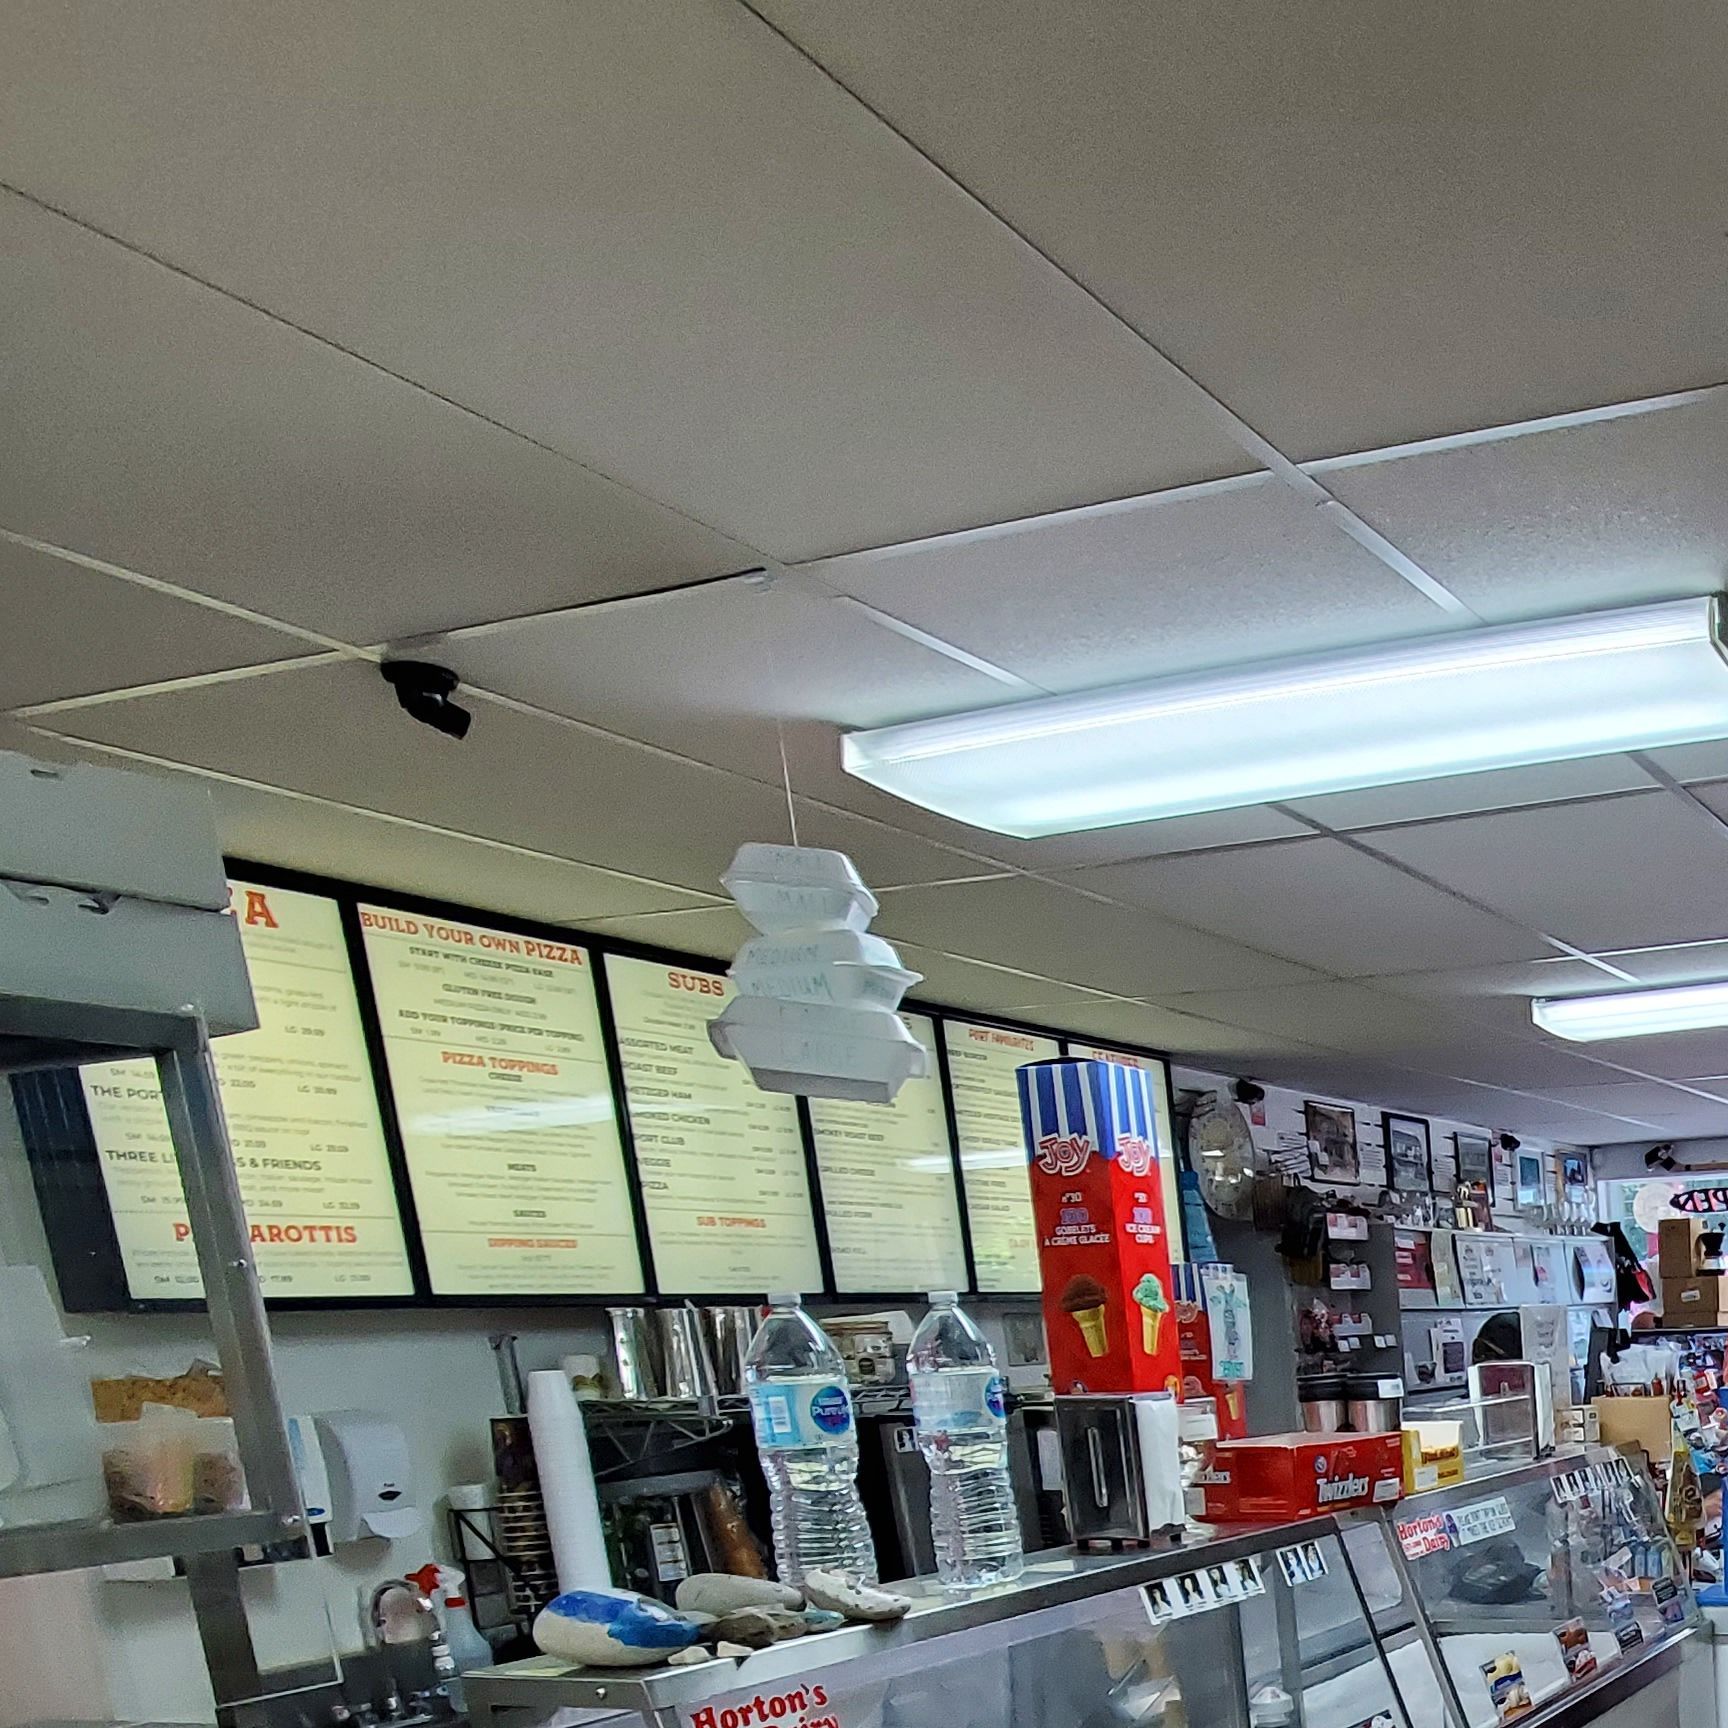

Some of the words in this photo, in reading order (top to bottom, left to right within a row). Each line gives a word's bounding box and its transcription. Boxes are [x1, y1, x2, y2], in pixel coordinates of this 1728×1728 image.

[360, 911, 419, 936] BUILD
[423, 923, 475, 946] YOUR
[479, 934, 521, 955] OWN
[524, 940, 584, 966] PIZZA
[409, 946, 442, 959] START
[667, 971, 725, 997] SUBS
[441, 1050, 486, 1067] PIZZA
[488, 1056, 559, 1076] TOPPINGS
[91, 1084, 125, 1099] THE
[104, 1149, 157, 1163] THREE
[248, 1157, 259, 1169] &
[262, 1158, 323, 1172] FRIENDS
[172, 1222, 358, 1244] PAROTTIS
[1316, 1473, 1370, 1505] Twizzlers
[1421, 1532, 1451, 1552] Dairy
